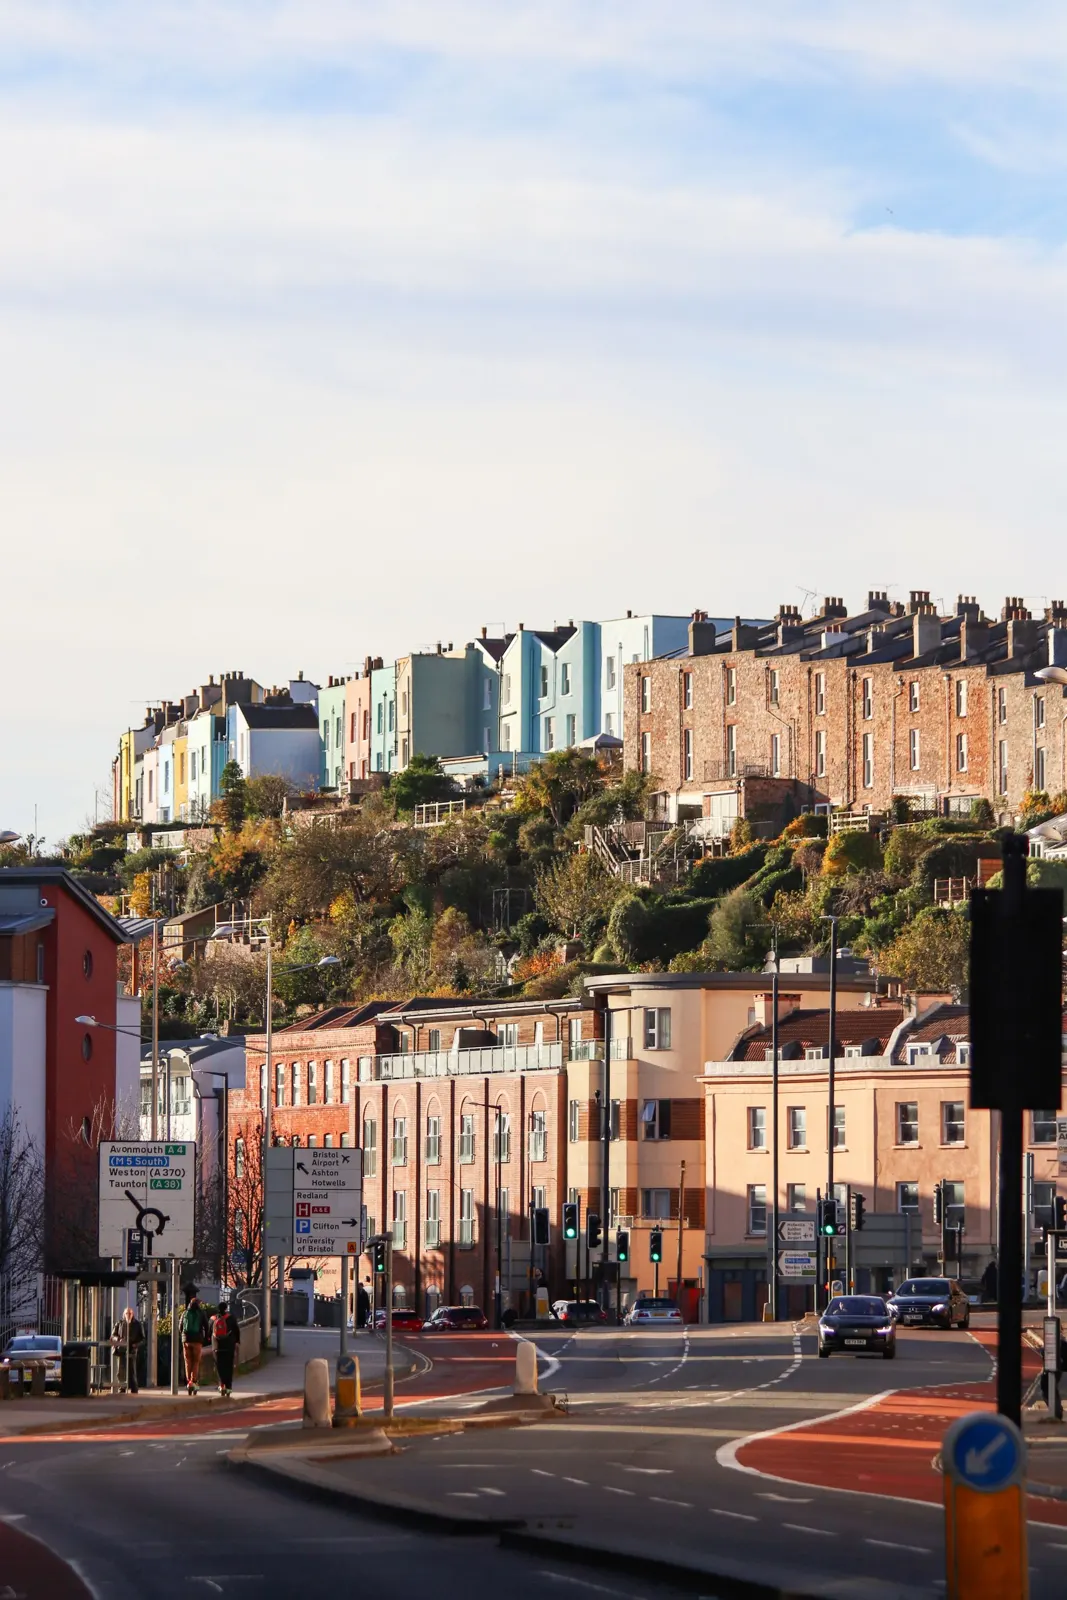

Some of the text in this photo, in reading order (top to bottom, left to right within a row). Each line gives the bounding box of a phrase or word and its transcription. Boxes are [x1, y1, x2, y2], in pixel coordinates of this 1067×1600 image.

[110, 1146, 163, 1154] Avonmouth
[110, 1168, 146, 1176] Weston
[298, 1204, 308, 1215] H
[300, 1221, 308, 1232] P
